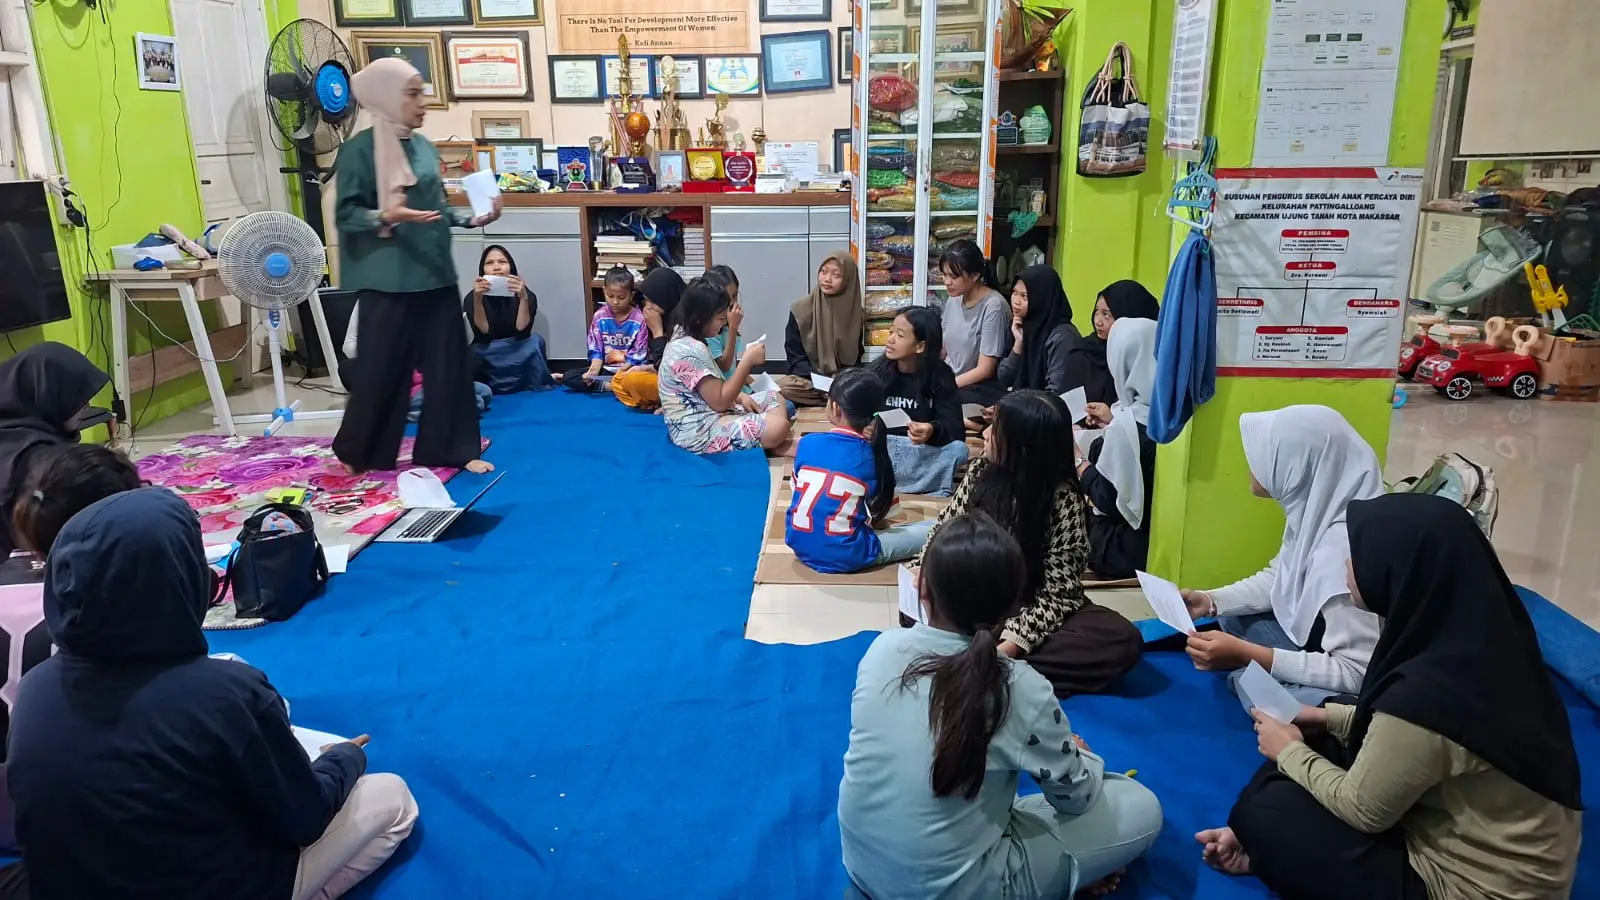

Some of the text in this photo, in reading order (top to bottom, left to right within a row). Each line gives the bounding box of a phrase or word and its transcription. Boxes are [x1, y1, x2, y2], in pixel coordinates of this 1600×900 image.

[567, 17, 589, 25] There
[637, 16, 685, 24] Development
[624, 25, 678, 34] Empowerment
[634, 39, 673, 47] Kofi Annan
[1224, 193, 1260, 201] SUSUNAN
[1399, 193, 1416, 201] DIRI
[1358, 213, 1400, 221] MAKASSAR
[791, 466, 868, 536] 77
